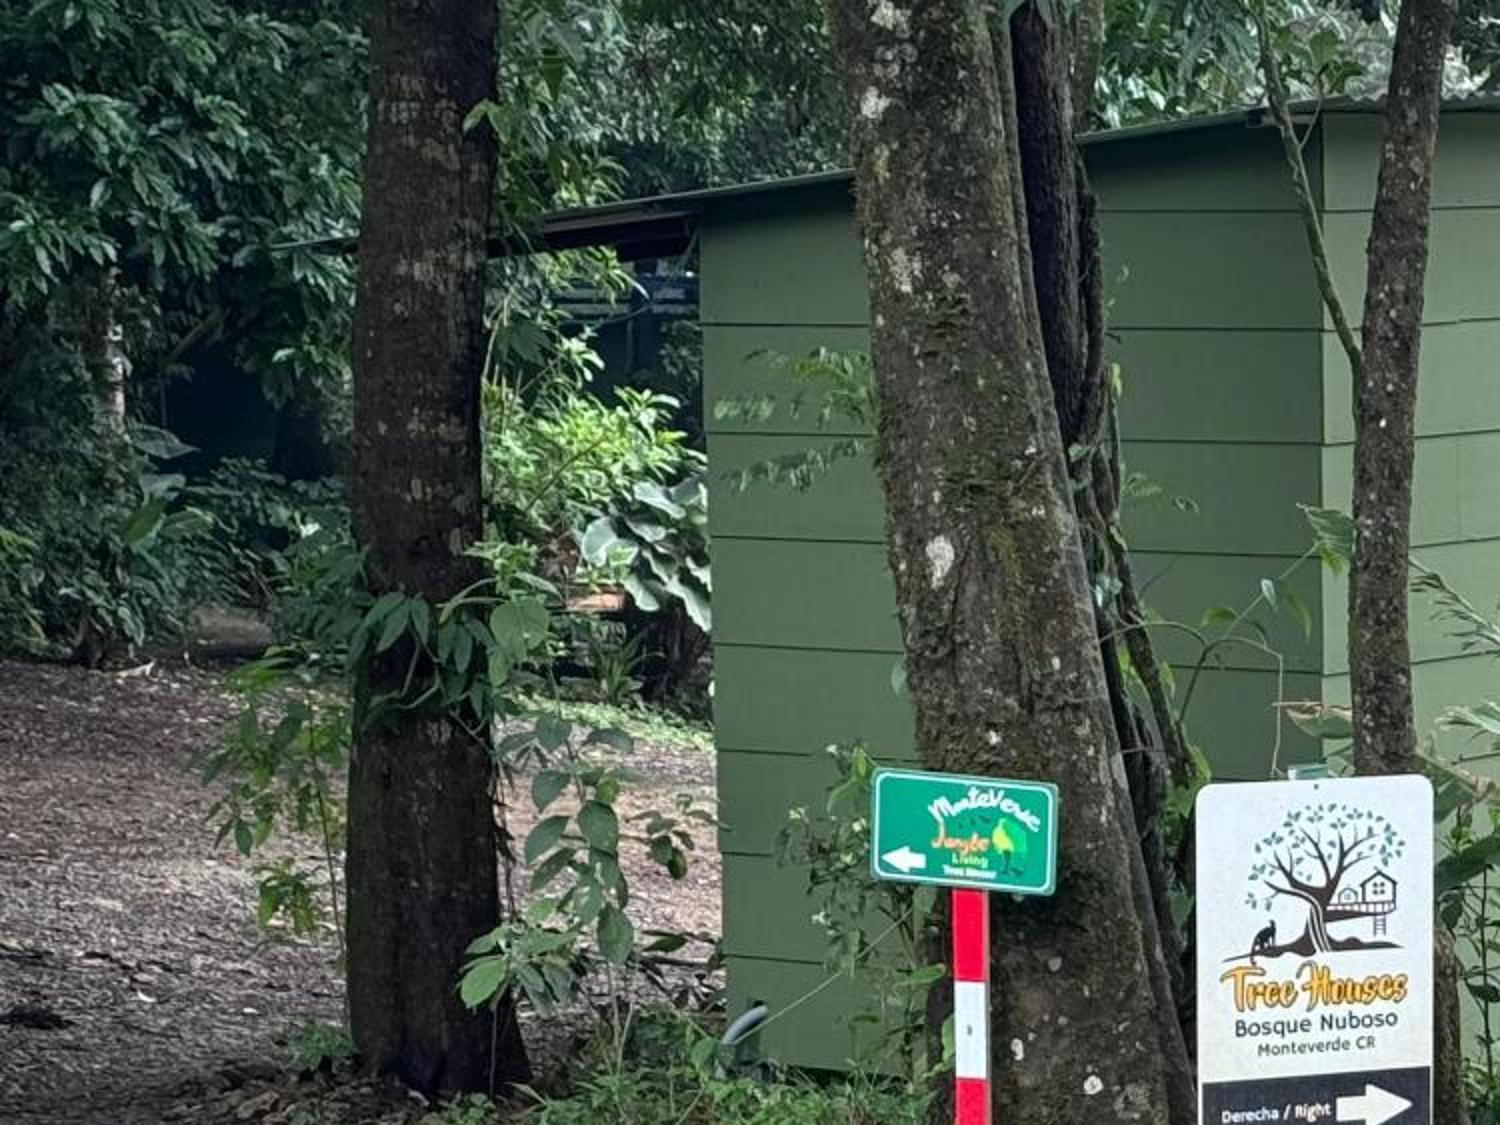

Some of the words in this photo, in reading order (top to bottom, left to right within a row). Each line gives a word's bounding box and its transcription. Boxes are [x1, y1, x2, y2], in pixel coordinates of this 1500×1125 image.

[1219, 965, 1299, 1012] Tree
[1296, 960, 1409, 1012] Houses
[1234, 1017, 1313, 1038] Bosque
[1320, 1011, 1399, 1032] Nuboso
[1257, 1037, 1351, 1057] Monteverde
[1355, 1035, 1376, 1050] CR
[1221, 1105, 1279, 1124] Derecha
[1283, 1104, 1291, 1120] /
[1294, 1102, 1332, 1123] Right
